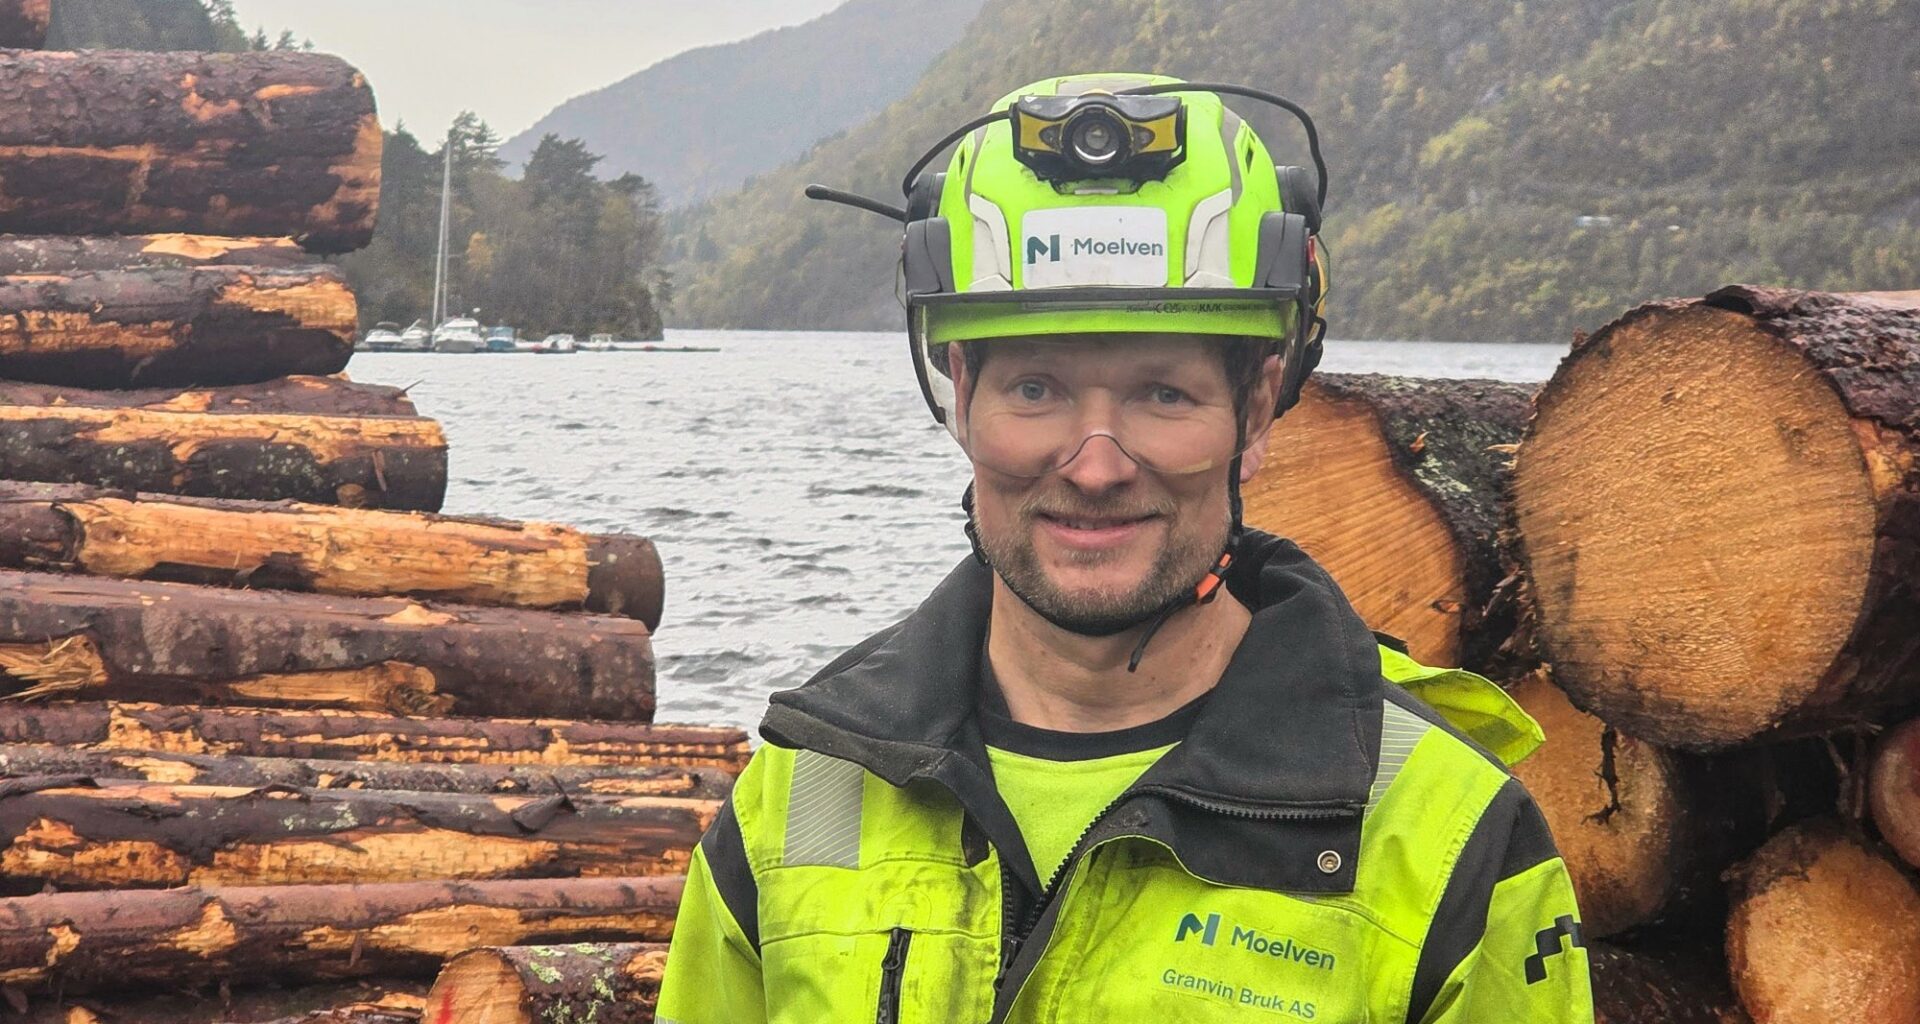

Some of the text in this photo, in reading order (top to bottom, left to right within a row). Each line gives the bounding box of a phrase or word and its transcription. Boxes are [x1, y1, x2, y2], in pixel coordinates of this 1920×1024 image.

[1073, 237, 1163, 256] Moelven
[1231, 926, 1336, 970] Moelven
[1163, 968, 1316, 1019] Granvin Bruk AS
